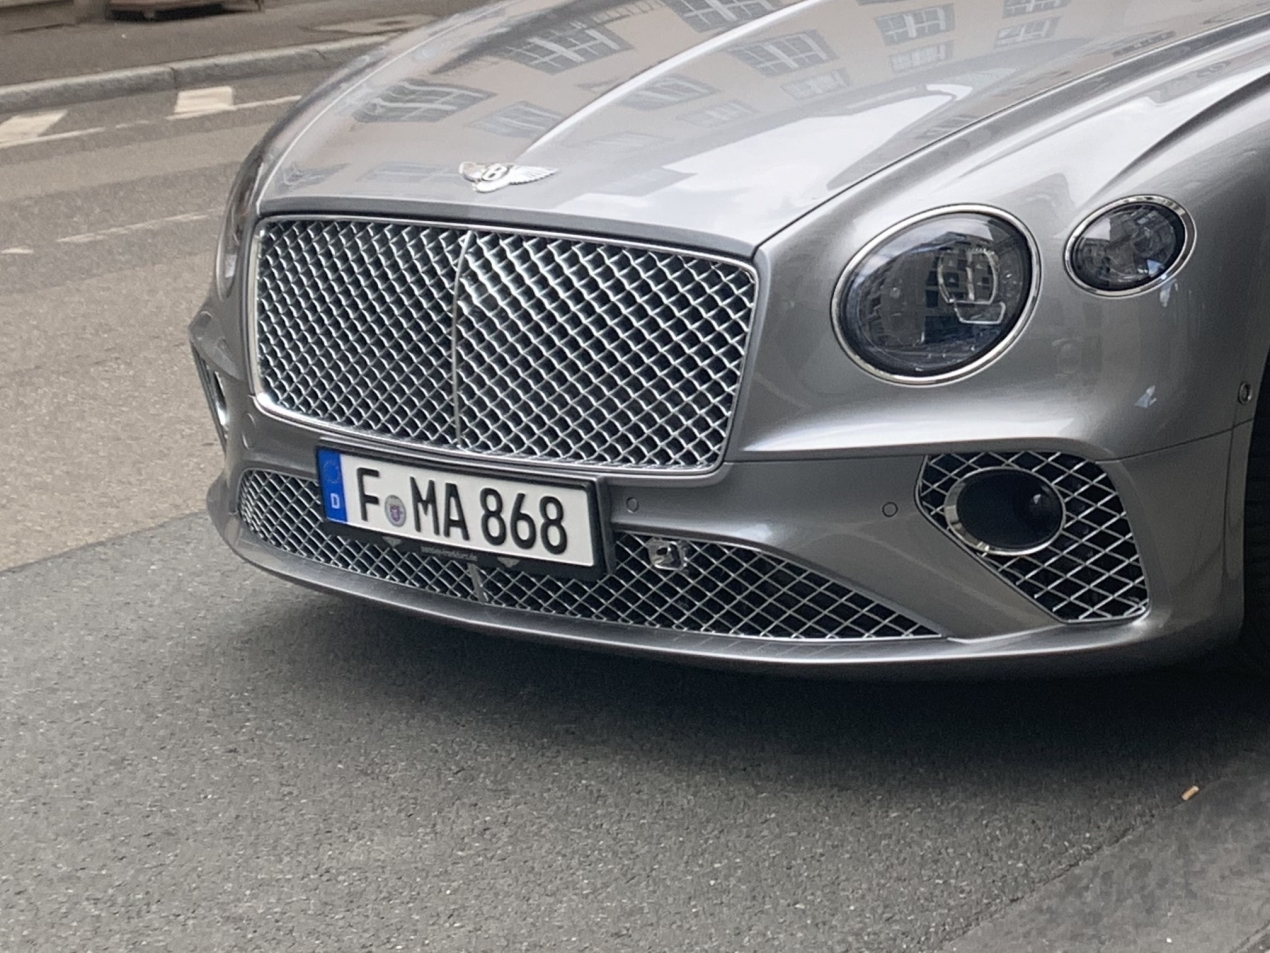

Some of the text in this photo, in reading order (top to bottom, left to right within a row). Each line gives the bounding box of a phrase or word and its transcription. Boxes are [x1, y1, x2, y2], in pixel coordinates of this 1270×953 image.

[330, 493, 341, 509] D
[355, 467, 568, 555] F MA 868
